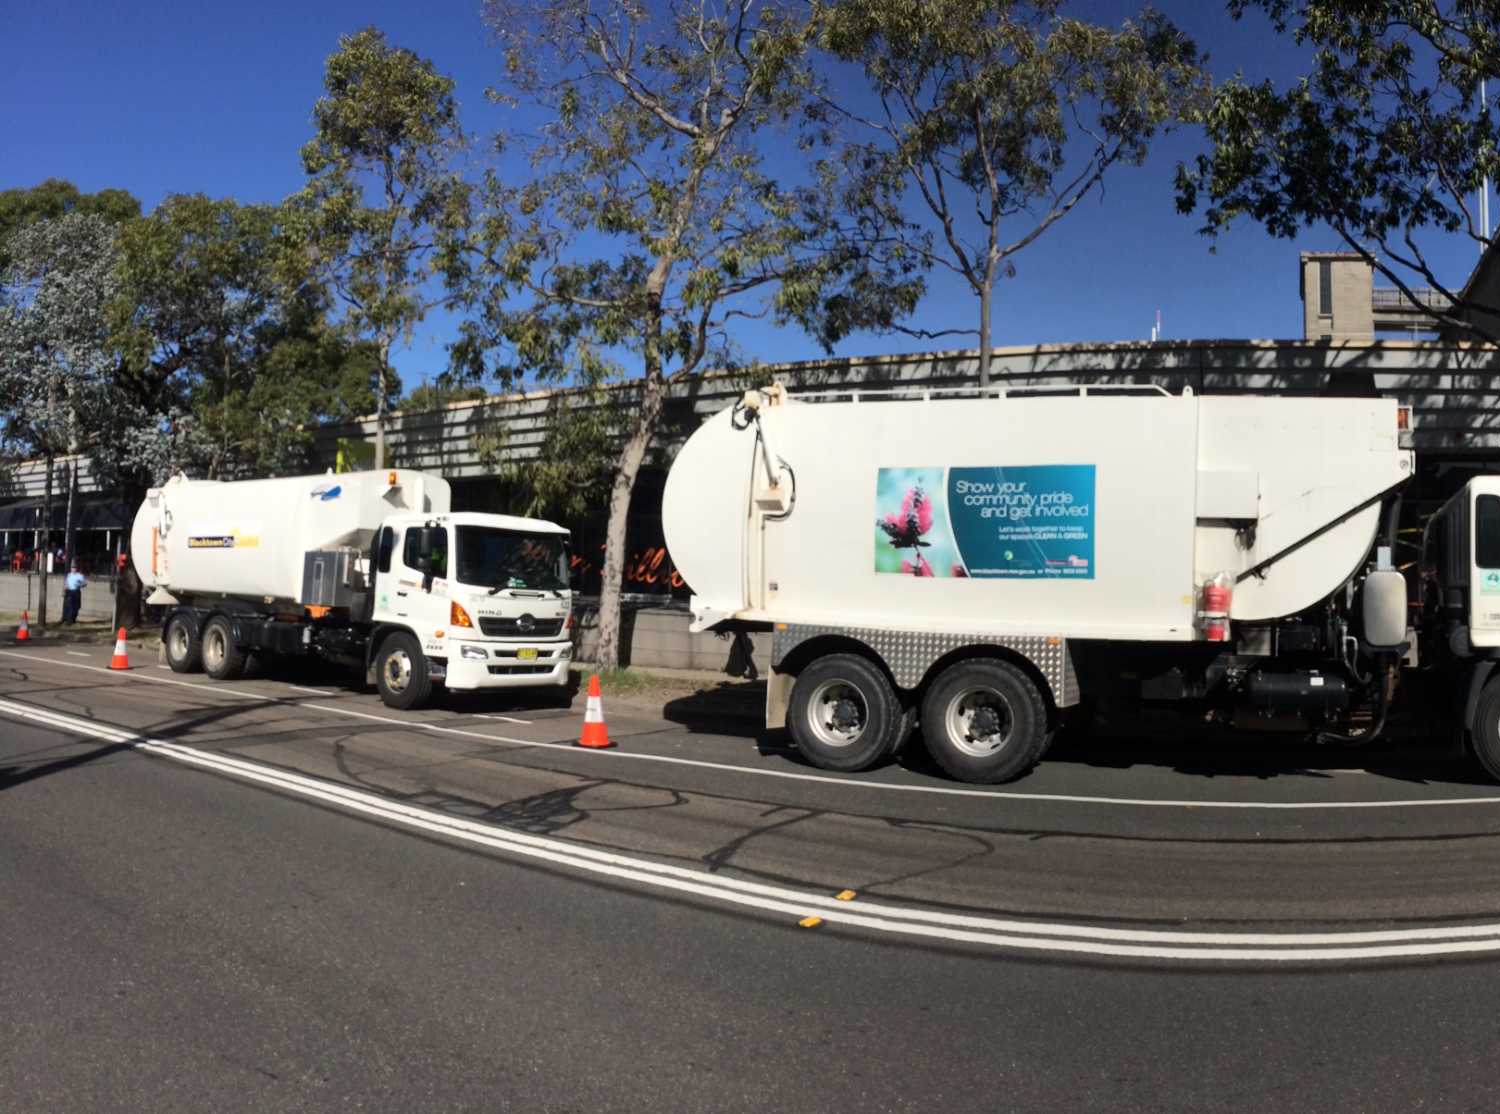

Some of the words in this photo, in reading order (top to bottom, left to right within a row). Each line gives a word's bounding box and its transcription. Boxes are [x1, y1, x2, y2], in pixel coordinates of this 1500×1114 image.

[956, 480, 994, 493] Show
[997, 482, 1027, 494] your
[964, 493, 1037, 505] community
[1041, 491, 1073, 506] pride
[980, 505, 1007, 518] and
[1009, 506, 1032, 520] get
[1036, 504, 1089, 516] involved
